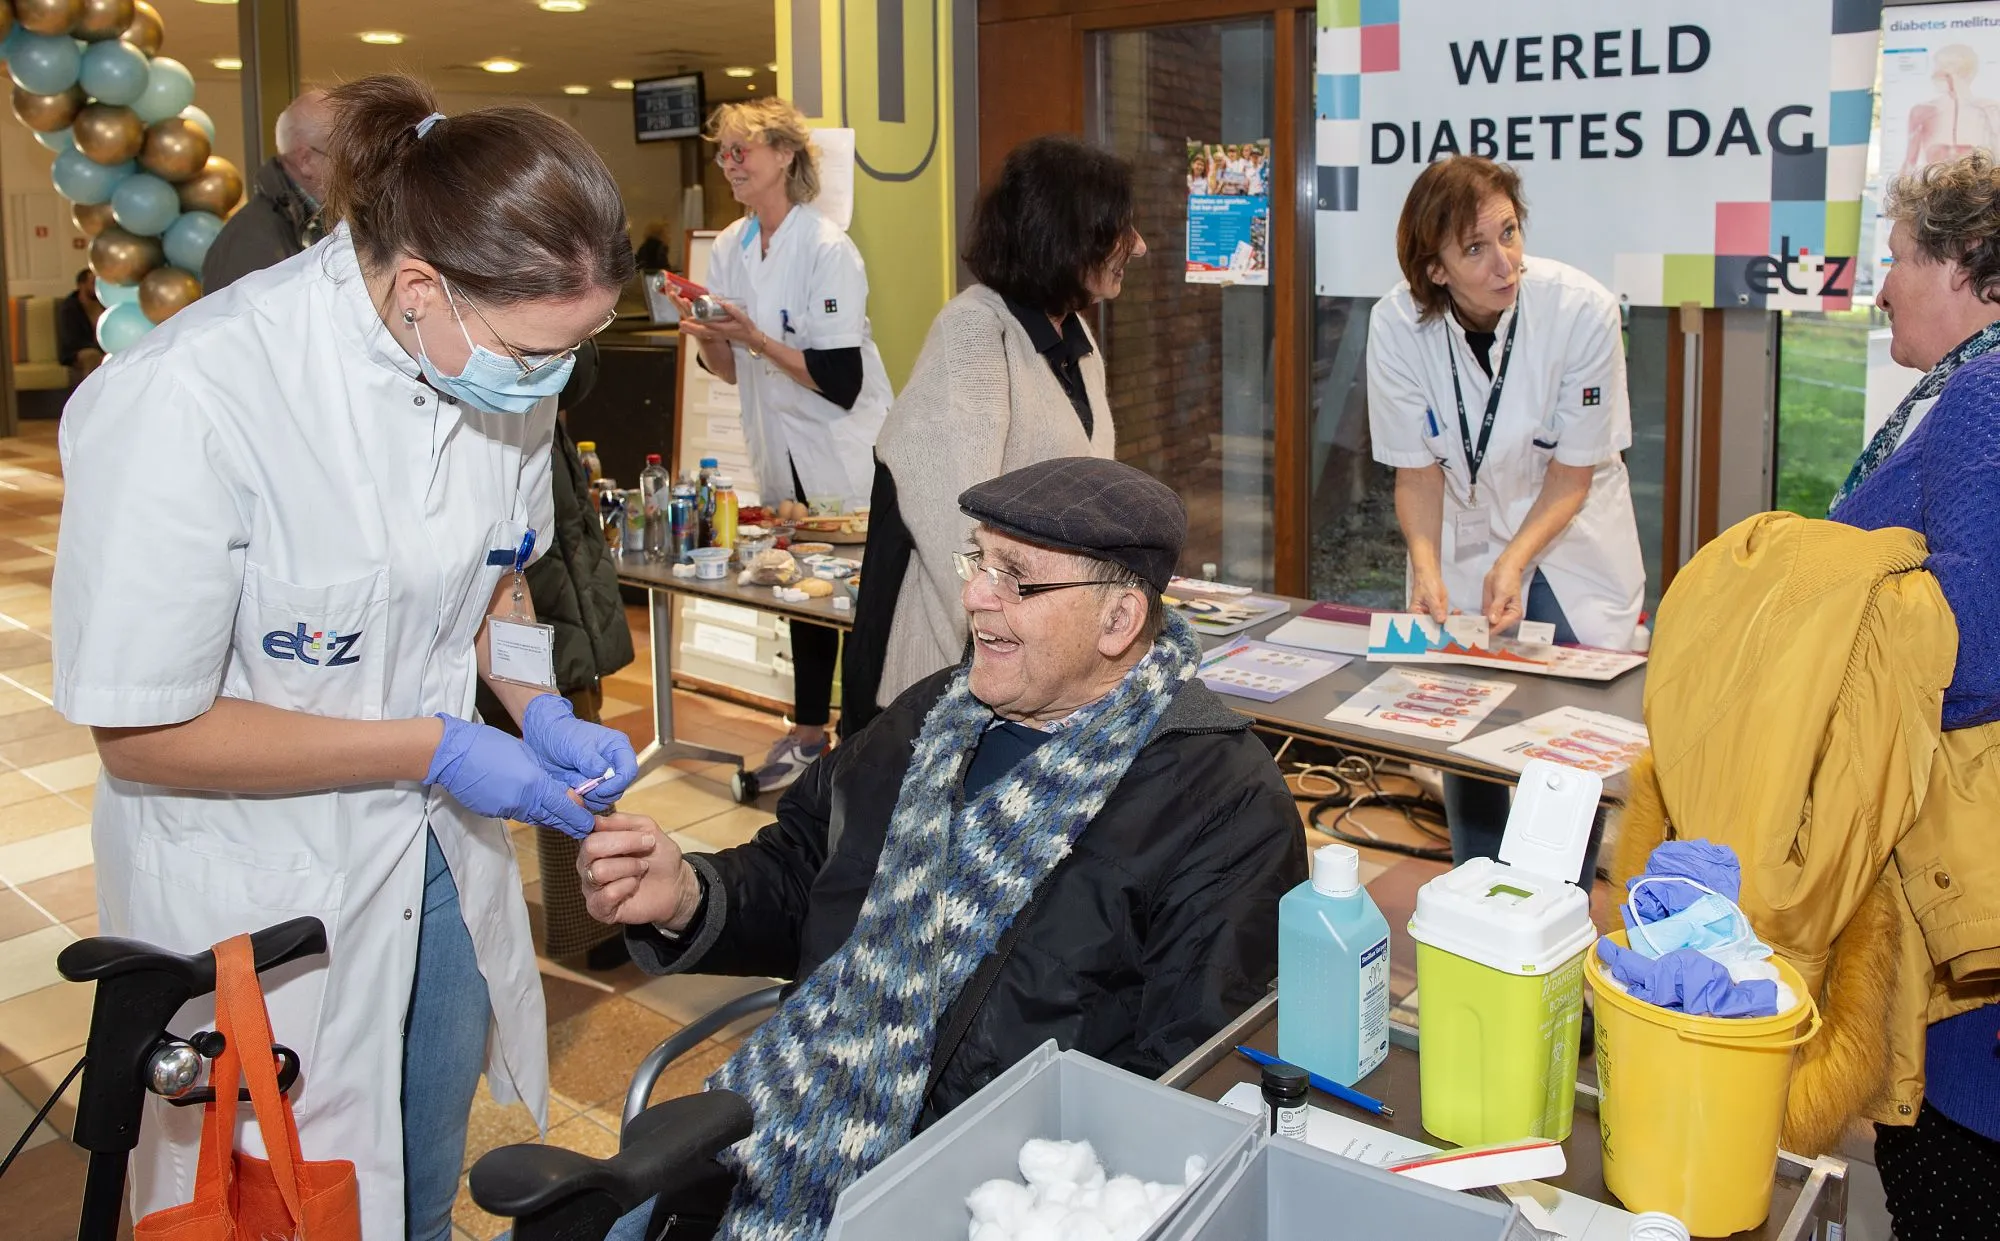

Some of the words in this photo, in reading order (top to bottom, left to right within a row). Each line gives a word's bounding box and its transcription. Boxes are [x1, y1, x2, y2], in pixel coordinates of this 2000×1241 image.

[1890, 19, 1946, 32] diabetes
[1951, 16, 2000, 28] mellitu
[1449, 24, 1711, 86] WERELD
[1371, 112, 1644, 165] DIABETES
[1668, 104, 1814, 157] DAG
[1745, 236, 1851, 296] etz
[262, 622, 363, 666] etz
[1551, 966, 1581, 991] DANGER
